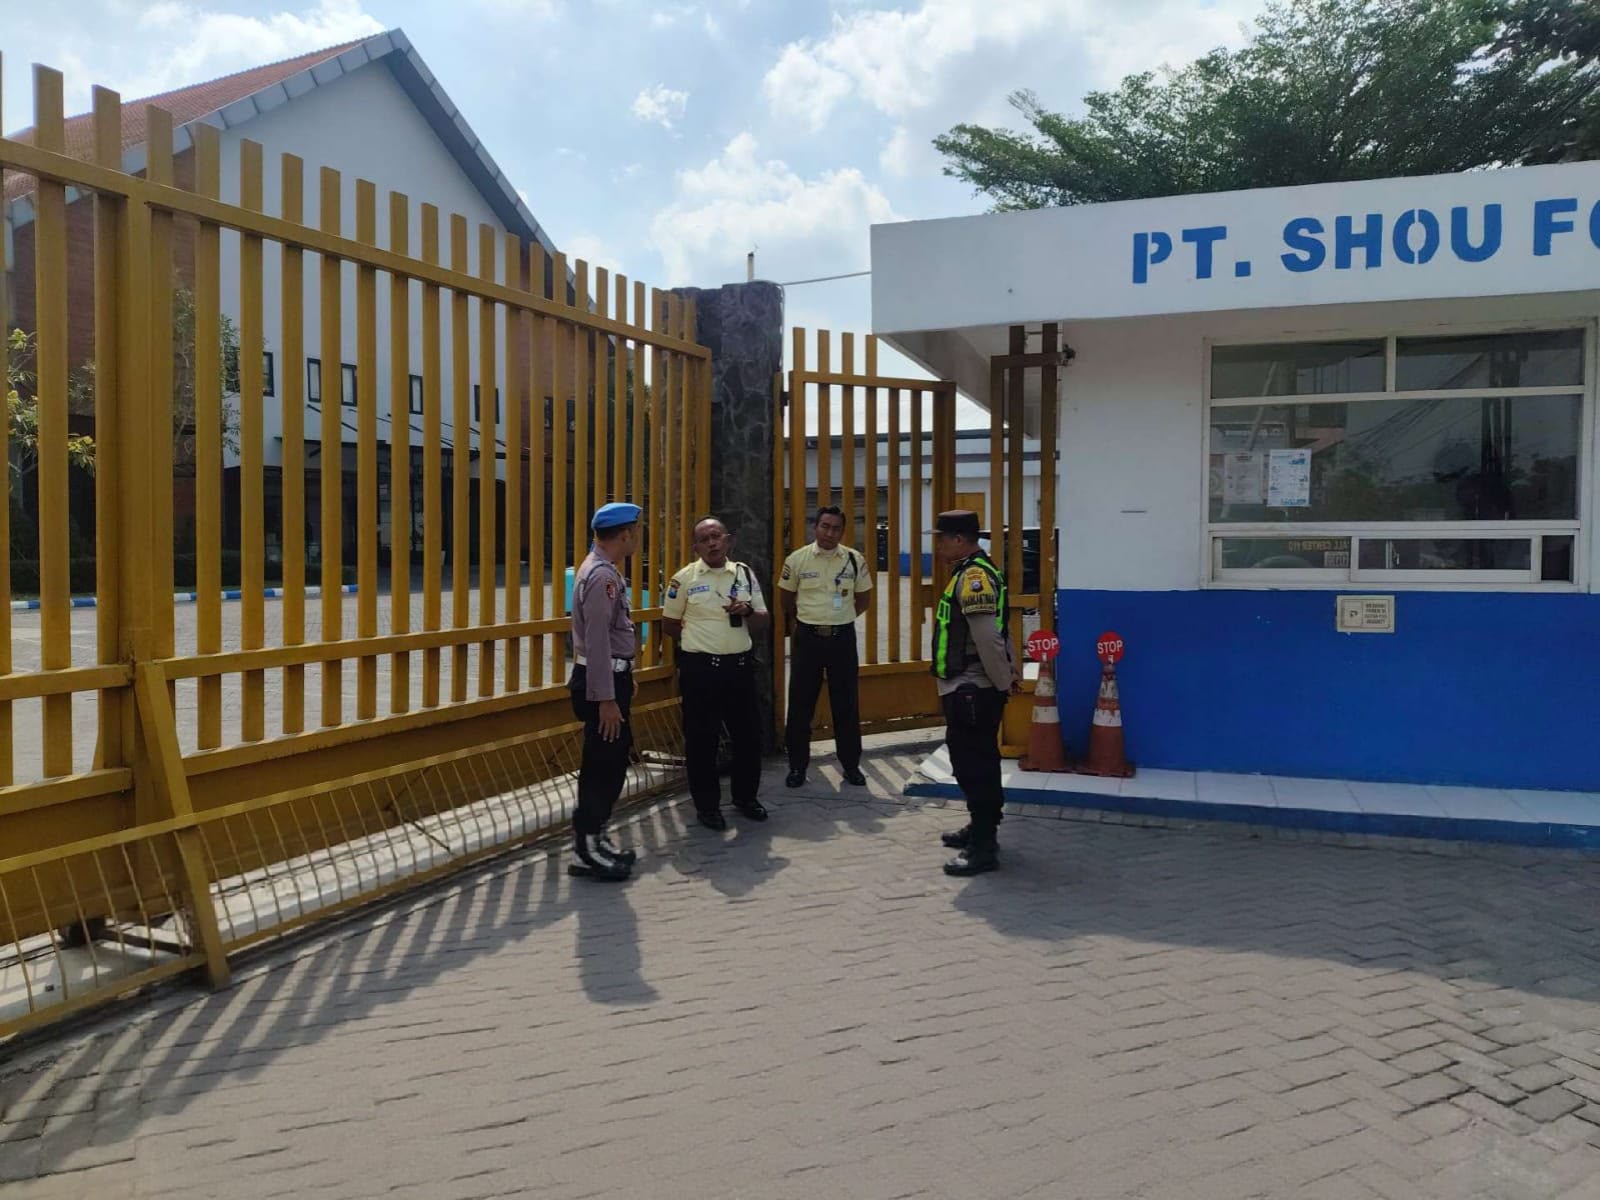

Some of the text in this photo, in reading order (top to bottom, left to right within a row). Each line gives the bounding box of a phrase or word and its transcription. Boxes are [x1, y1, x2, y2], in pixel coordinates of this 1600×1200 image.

[1132, 198, 1600, 284] PT. SHOU F
[1027, 637, 1058, 653] STOP
[1097, 640, 1123, 654] STOP
